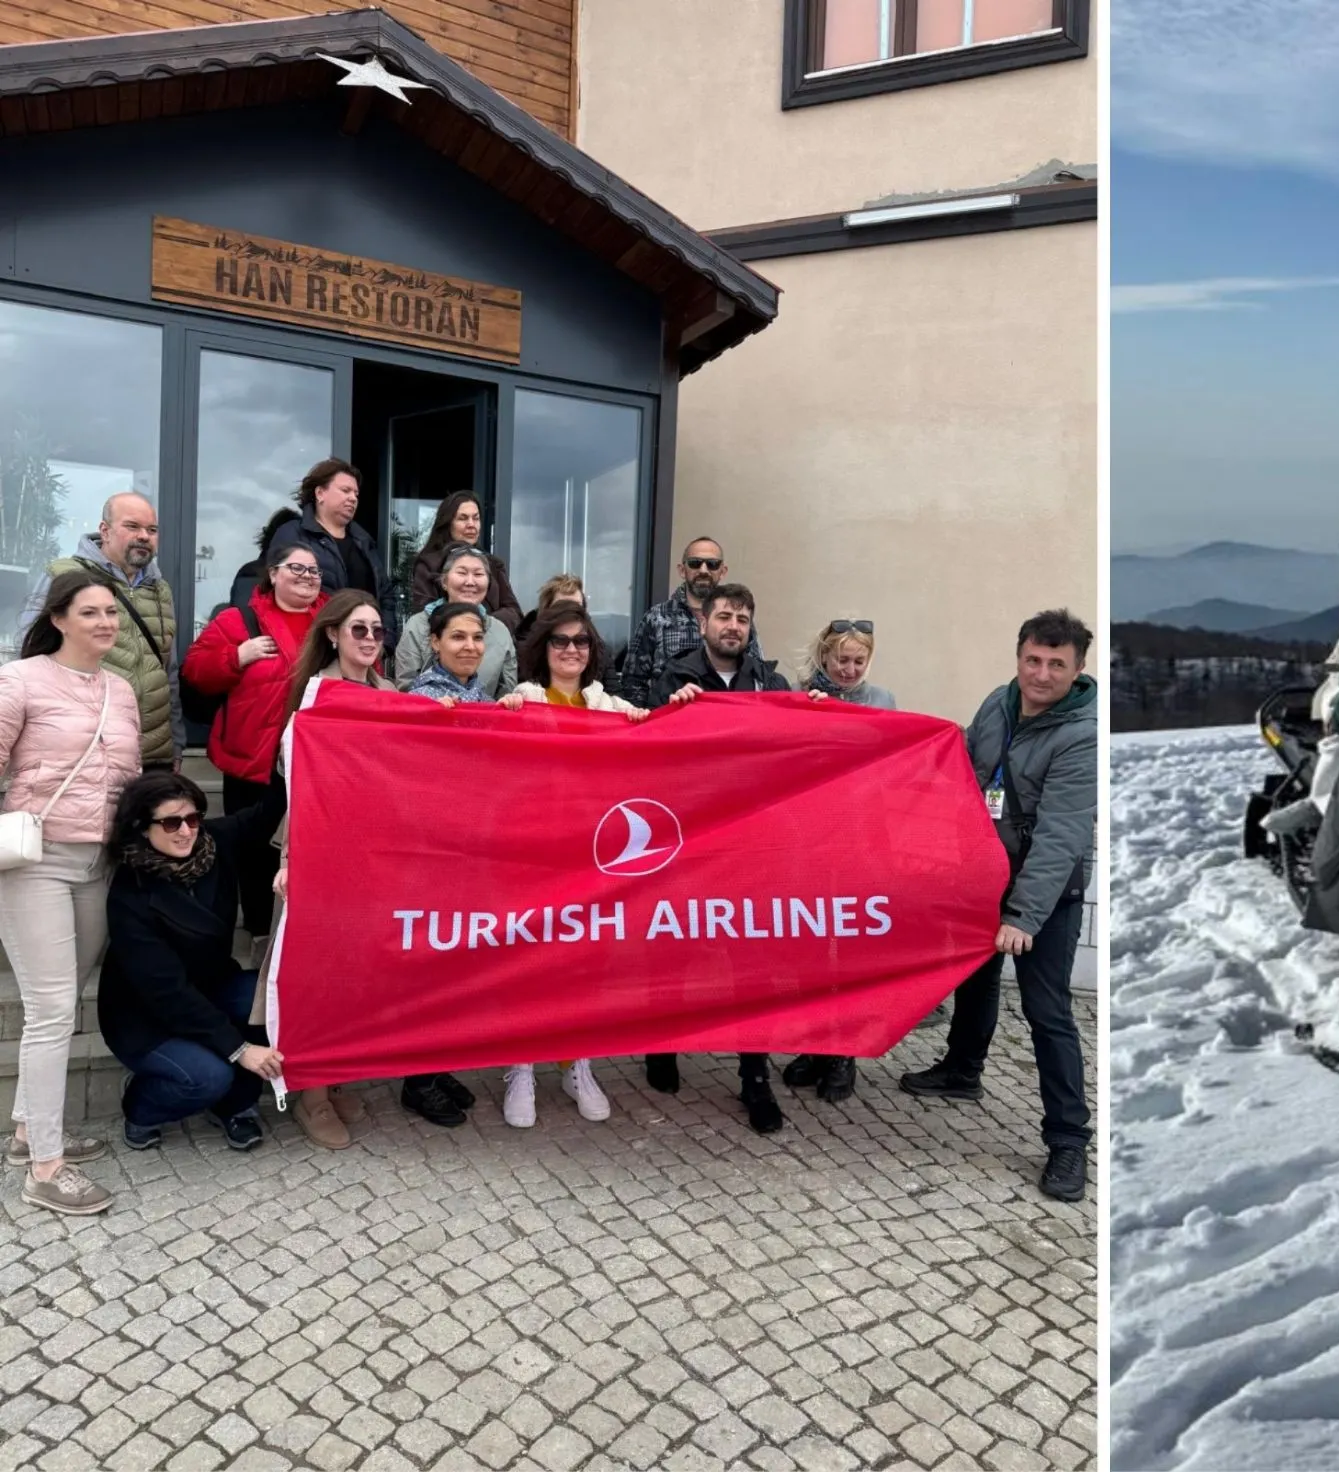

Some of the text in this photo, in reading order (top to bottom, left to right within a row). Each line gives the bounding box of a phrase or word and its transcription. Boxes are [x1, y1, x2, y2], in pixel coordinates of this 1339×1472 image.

[215, 256, 480, 341] HAN RESTORAN
[393, 895, 893, 951] TURKISH AIRLINES
